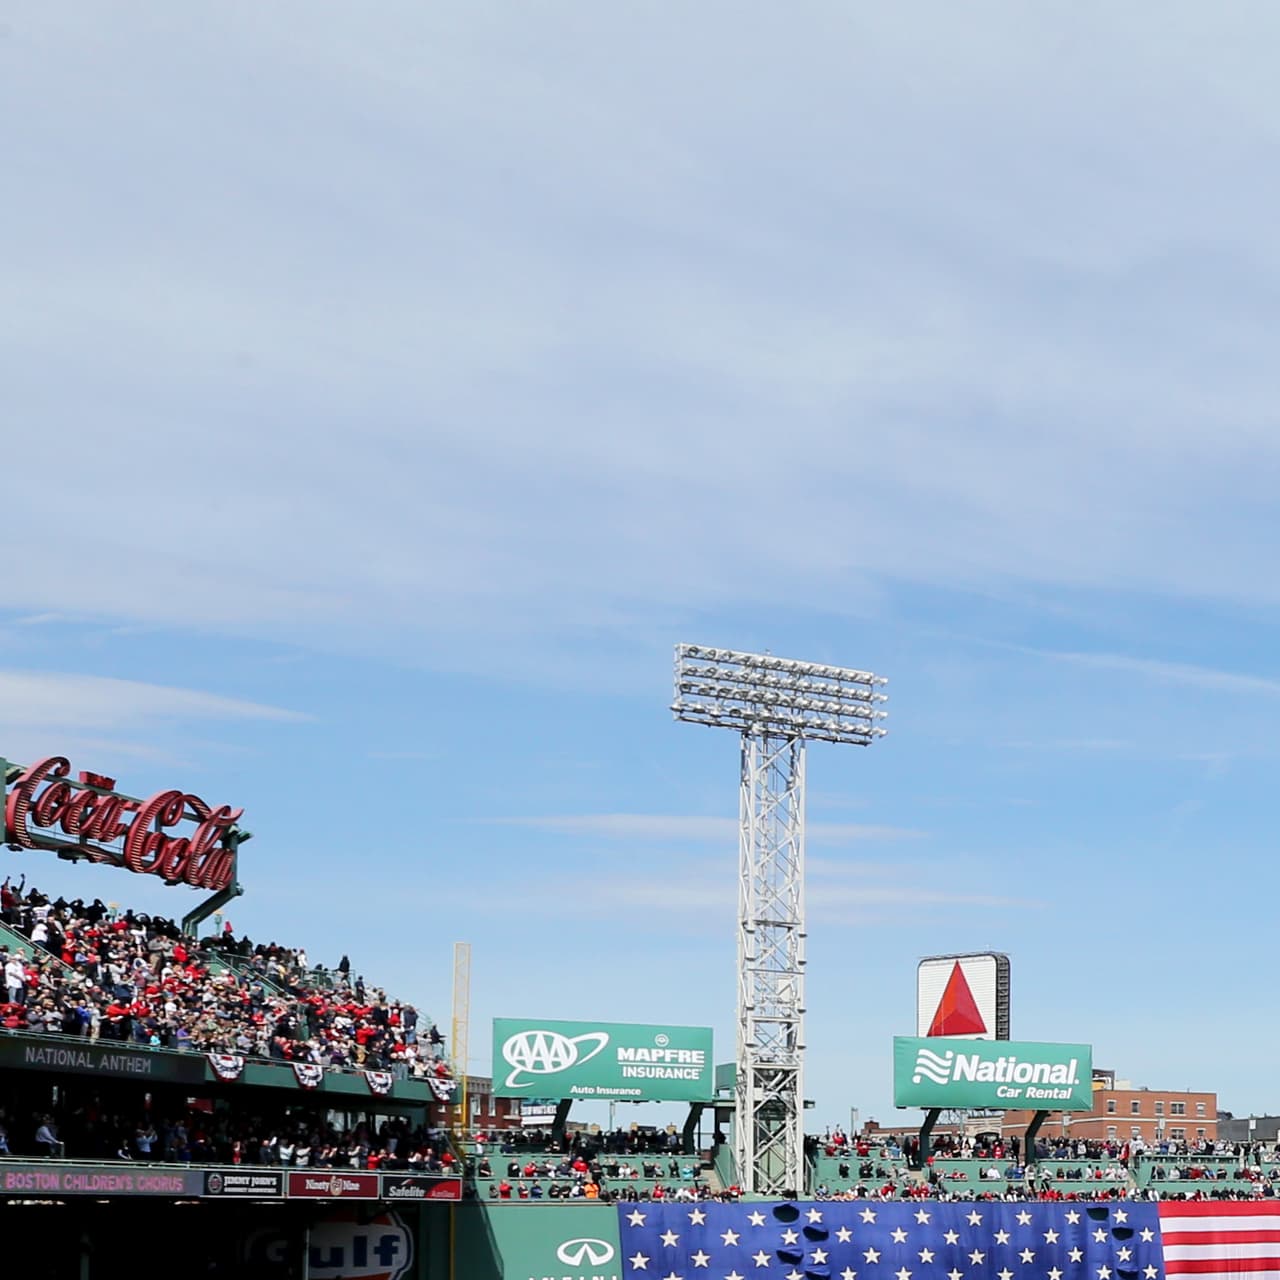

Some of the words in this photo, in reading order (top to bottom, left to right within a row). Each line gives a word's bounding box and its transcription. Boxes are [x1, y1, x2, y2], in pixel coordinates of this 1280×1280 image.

[5, 756, 244, 890] Coca-Cola
[509, 1032, 569, 1071] AAA
[617, 1047, 704, 1064] MAPFRE
[25, 1047, 94, 1068] NATIONAL
[100, 1054, 151, 1073] ANTHEM
[622, 1066, 700, 1080] INSURANCE
[570, 1085, 594, 1095] Auto
[596, 1086, 641, 1096] Insurance
[997, 1086, 1021, 1098] Car
[1025, 1086, 1071, 1099] Rental
[6, 1172, 59, 1190] BOSTON
[64, 1173, 133, 1192] CHILDREN'S
[137, 1175, 183, 1193] CHORUS
[343, 1179, 360, 1190] Nine
[389, 1186, 425, 1197] Safelite
